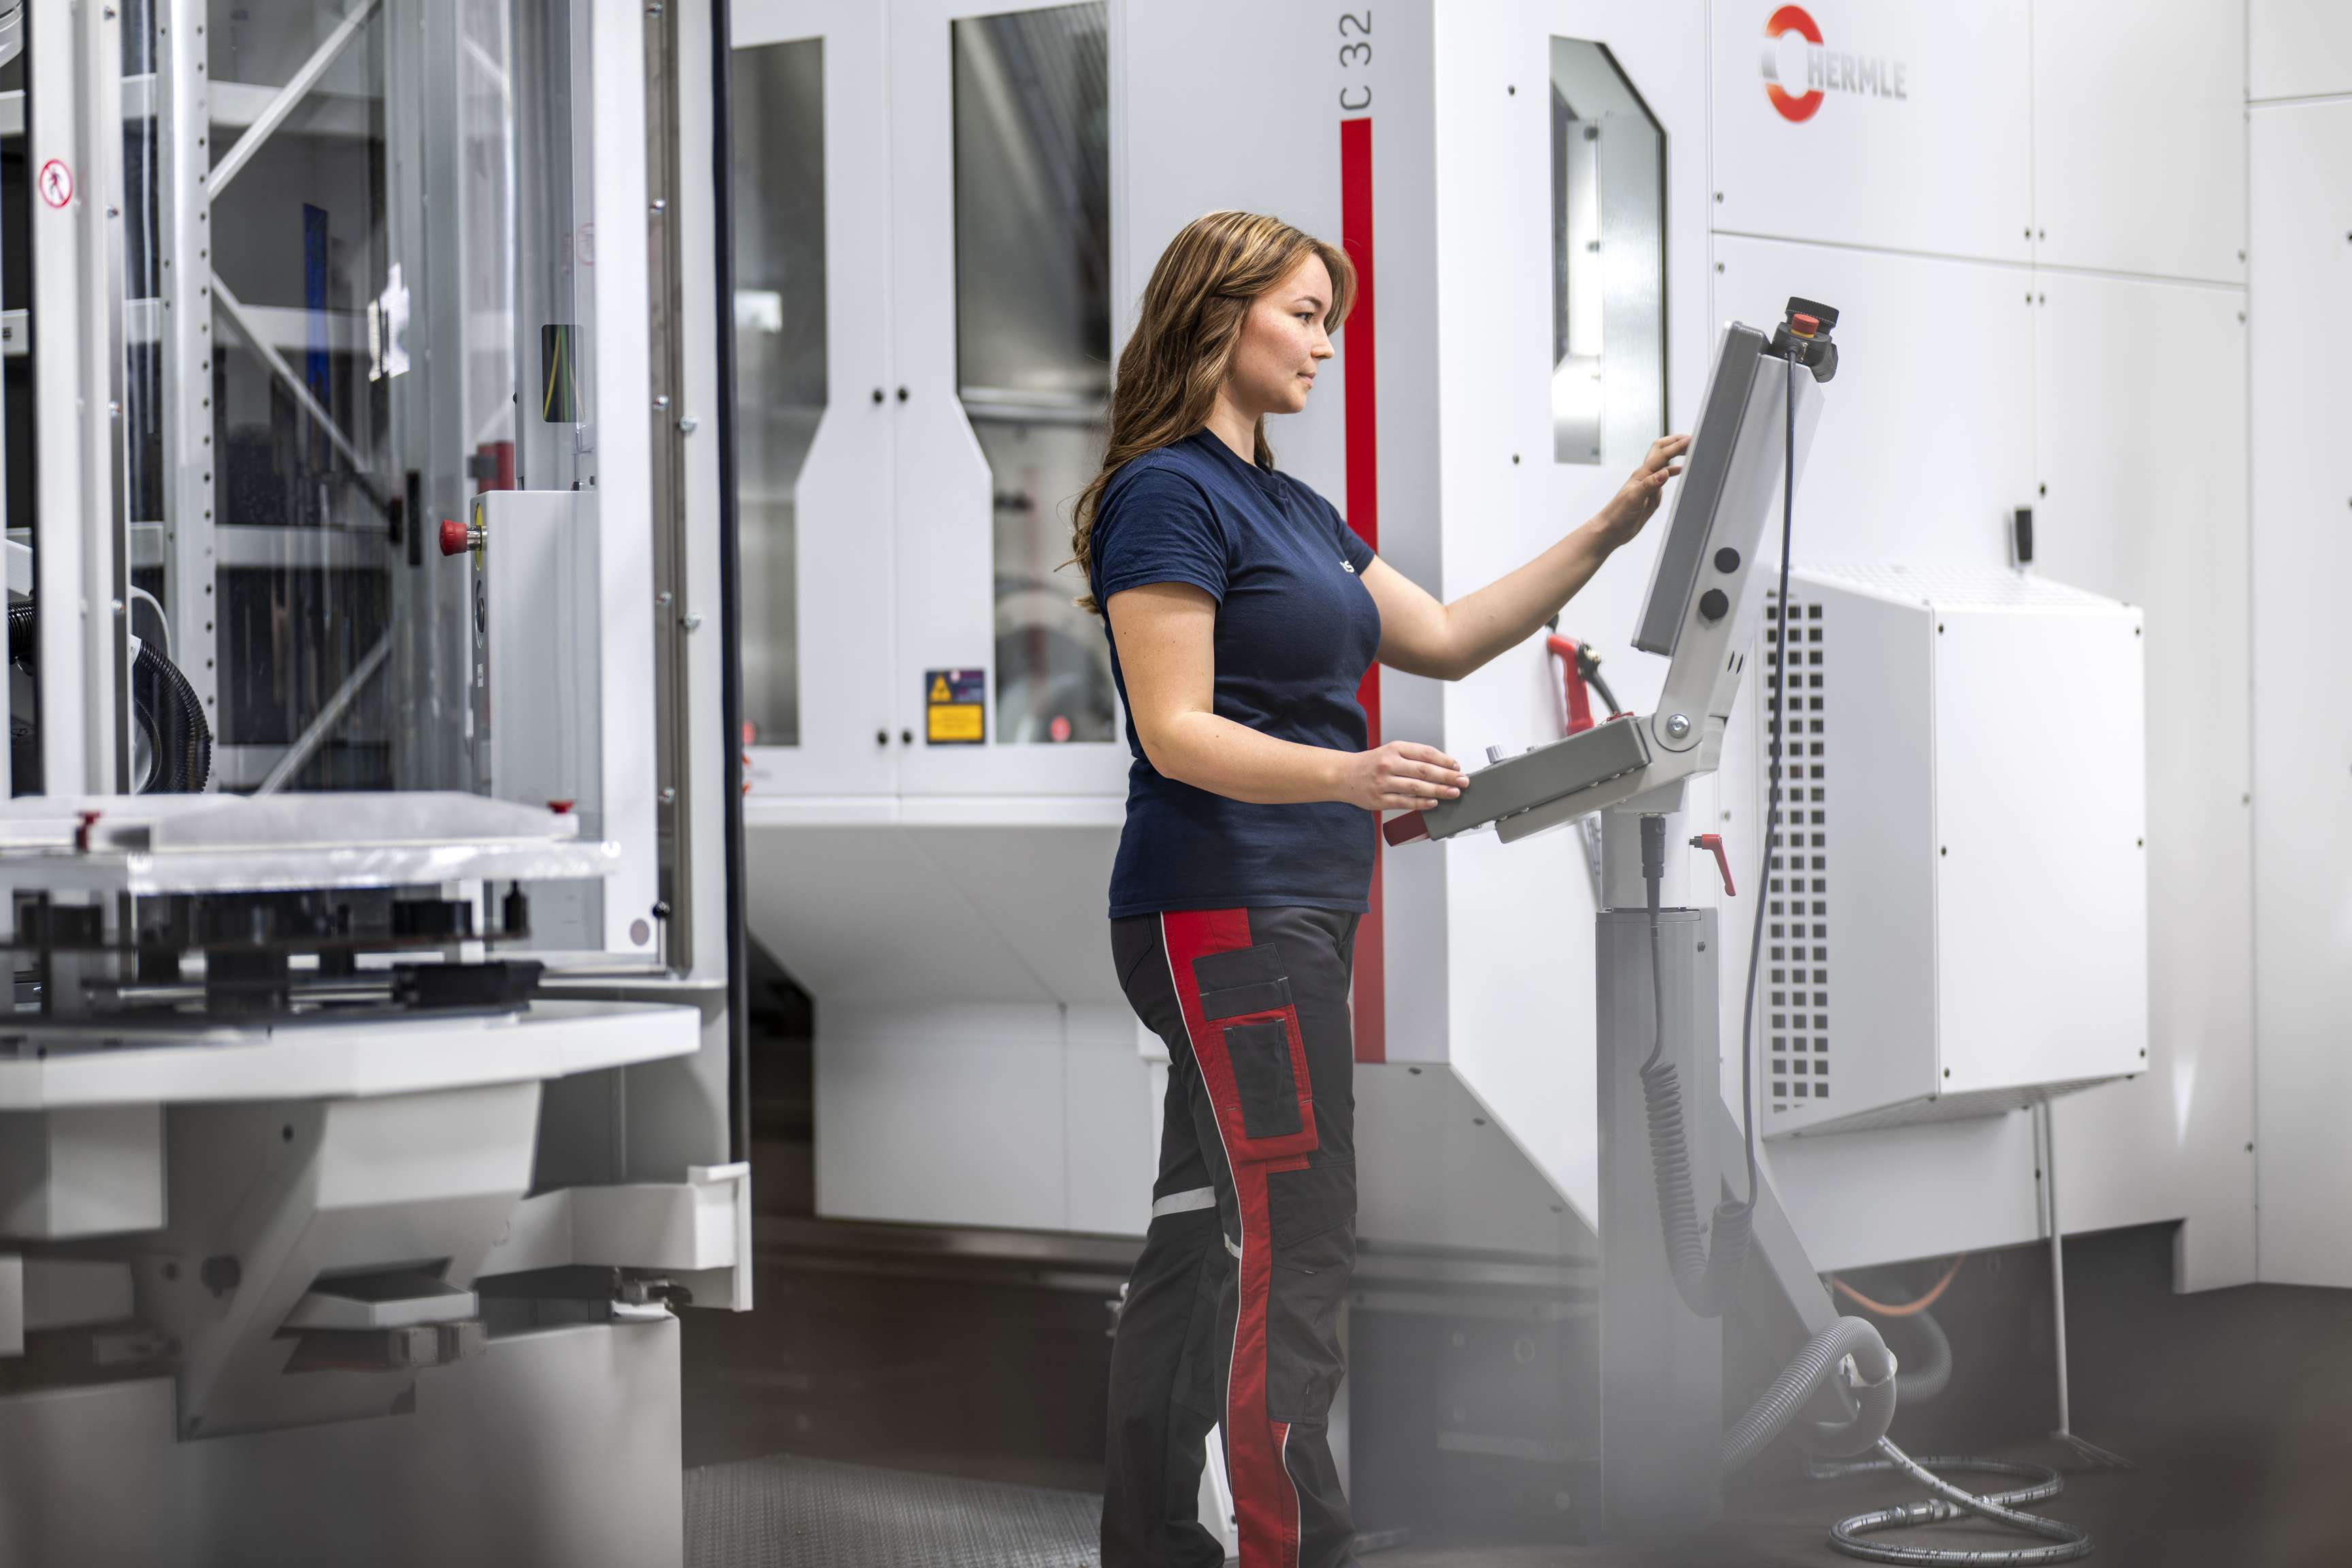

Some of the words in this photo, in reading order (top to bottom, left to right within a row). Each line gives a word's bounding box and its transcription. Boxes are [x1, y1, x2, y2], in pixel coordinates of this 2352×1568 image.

[1339, 10, 1372, 67] 32
[1339, 85, 1372, 110] C
[1807, 47, 1908, 101] HERMLE
